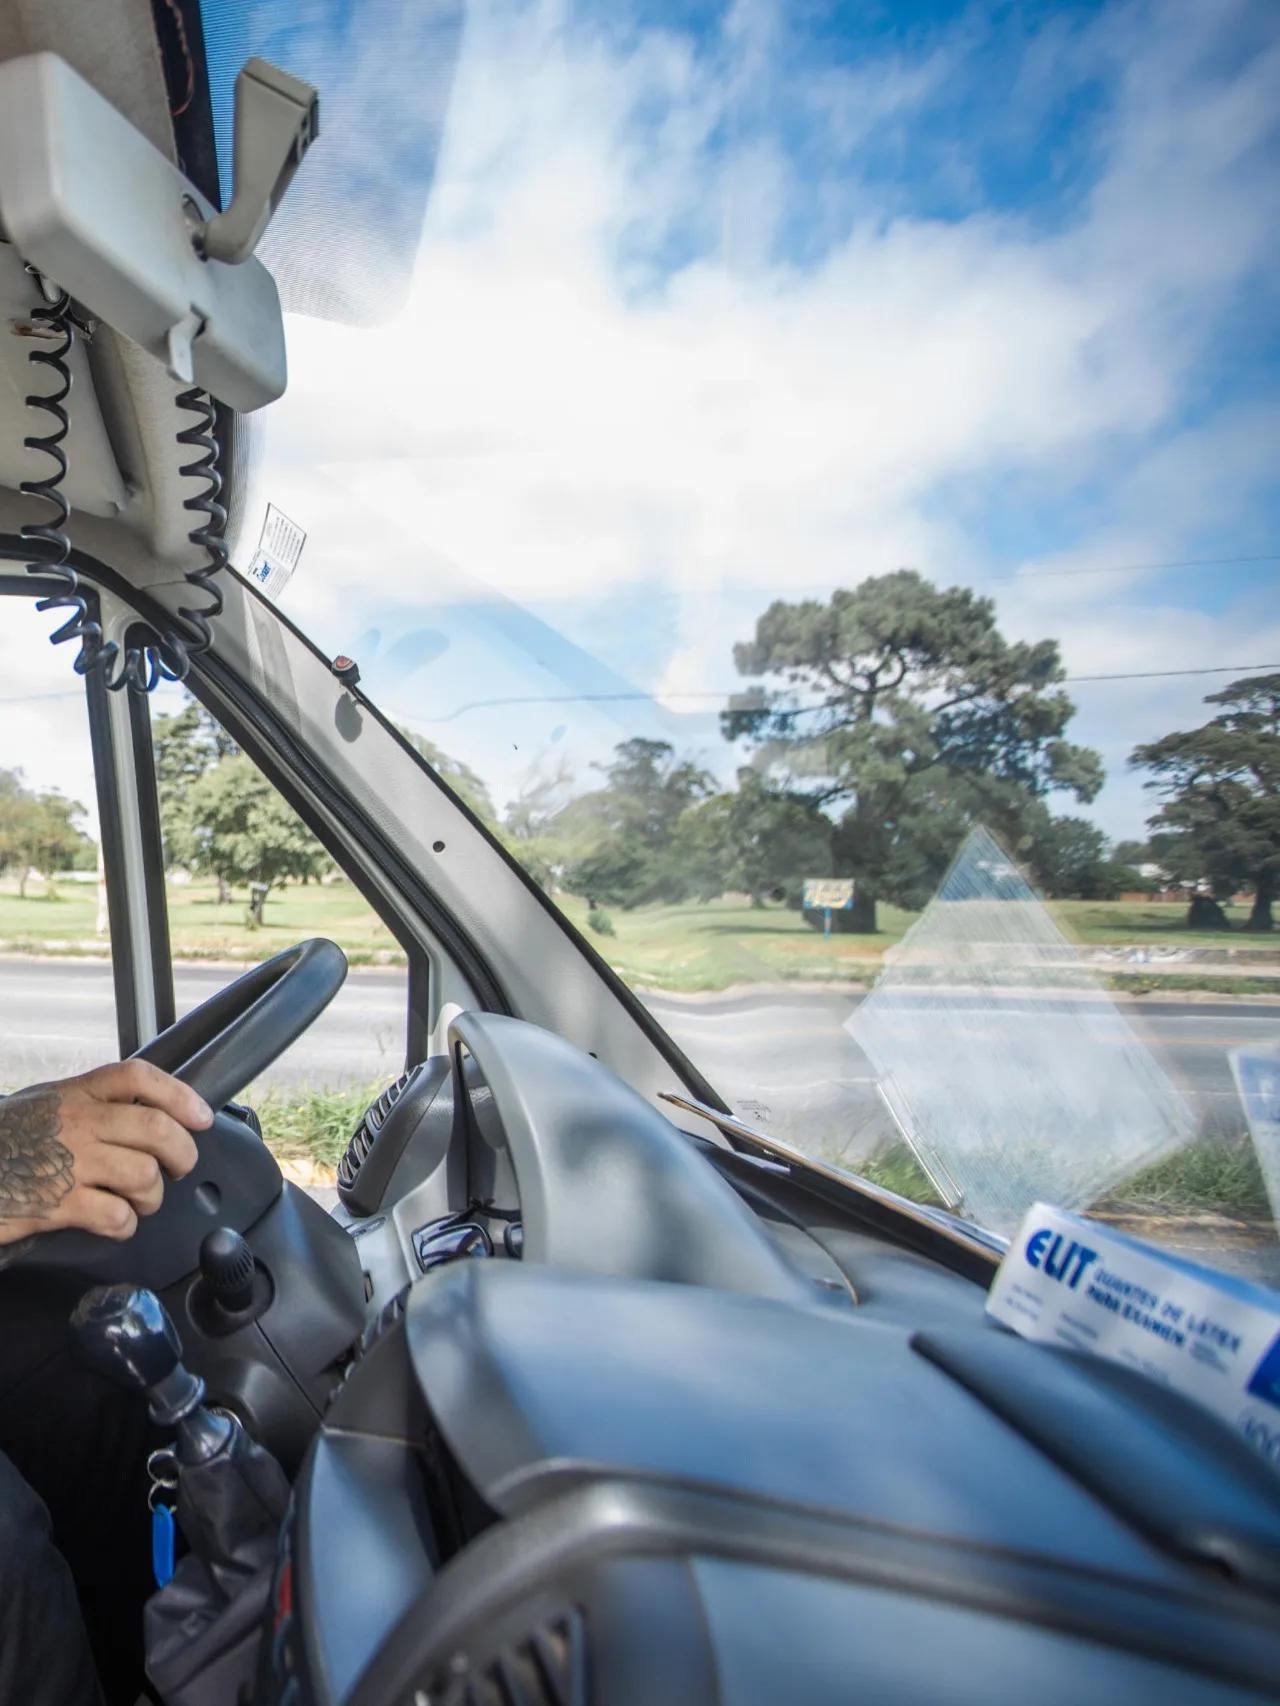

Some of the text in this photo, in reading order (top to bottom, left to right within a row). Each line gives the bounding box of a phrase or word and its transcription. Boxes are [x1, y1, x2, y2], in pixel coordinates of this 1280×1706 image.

[1026, 1230, 1098, 1290] ELIT
[1086, 1283, 1120, 1313] PARA
[1122, 1302, 1185, 1347] EXAMEN
